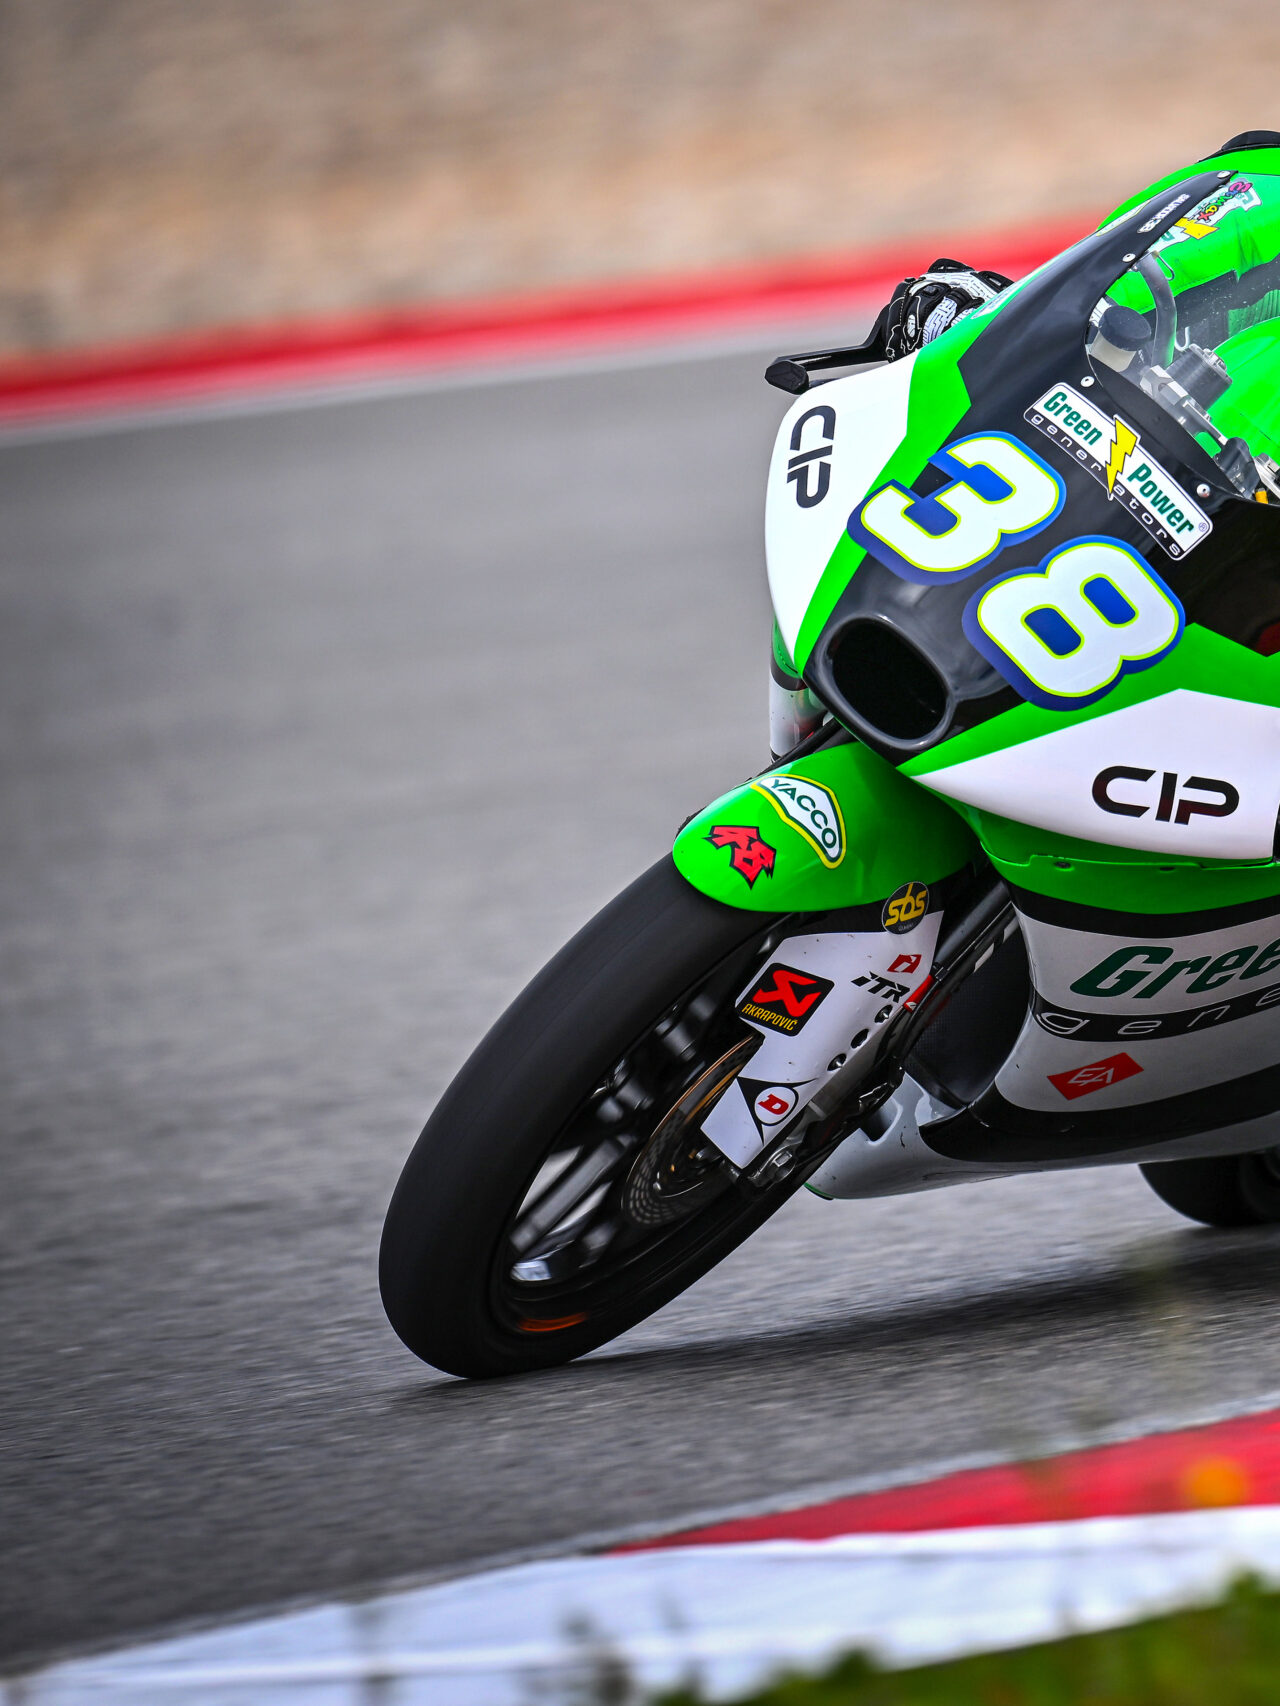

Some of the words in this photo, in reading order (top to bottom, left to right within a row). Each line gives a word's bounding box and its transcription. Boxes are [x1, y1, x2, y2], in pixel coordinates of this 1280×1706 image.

[787, 406, 836, 508] CIP
[1030, 414, 1183, 558] generators
[1043, 392, 1103, 446] Green
[1127, 463, 1194, 535] Power
[848, 432, 1185, 709] 38
[770, 778, 838, 849] YACCO
[1091, 765, 1240, 826] CIP
